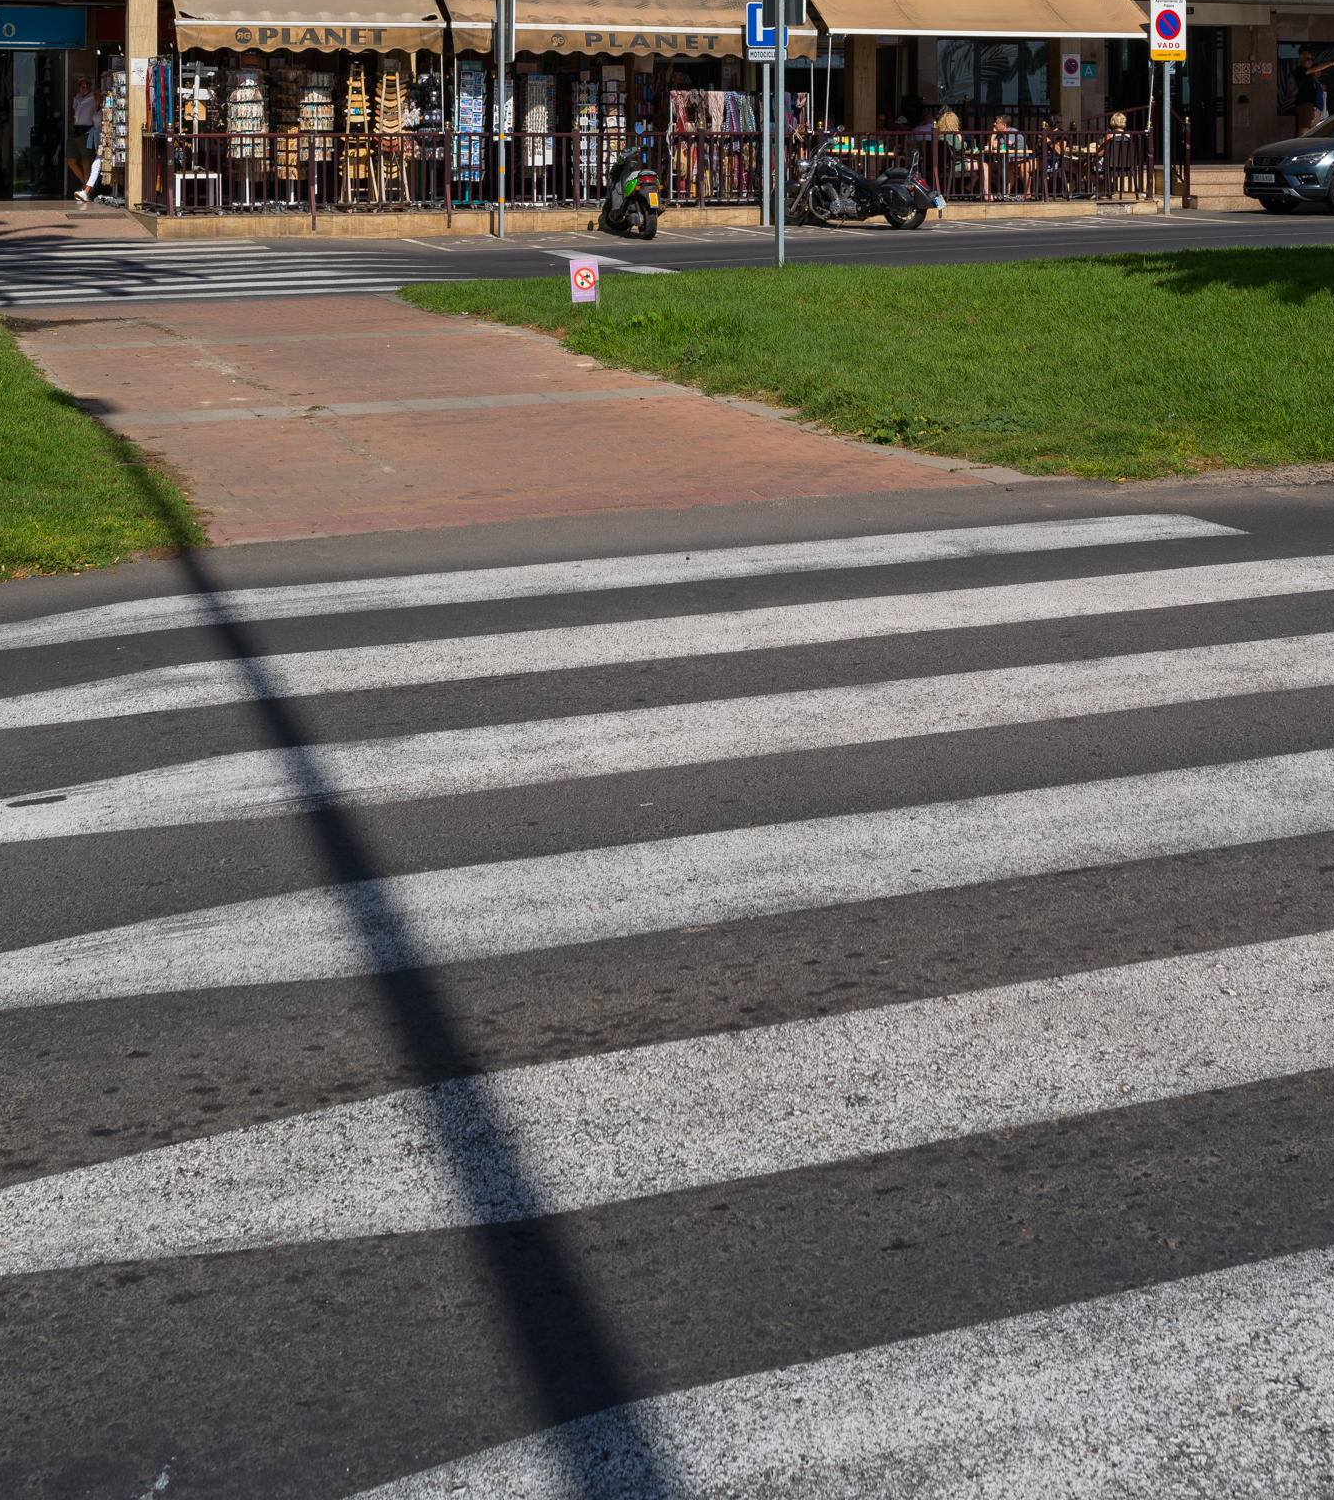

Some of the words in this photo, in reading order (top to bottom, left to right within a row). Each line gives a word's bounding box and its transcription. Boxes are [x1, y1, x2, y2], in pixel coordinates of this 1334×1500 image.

[258, 27, 388, 46] PLANET
[584, 32, 719, 50] PLANET
[1084, 65, 1094, 77] A
